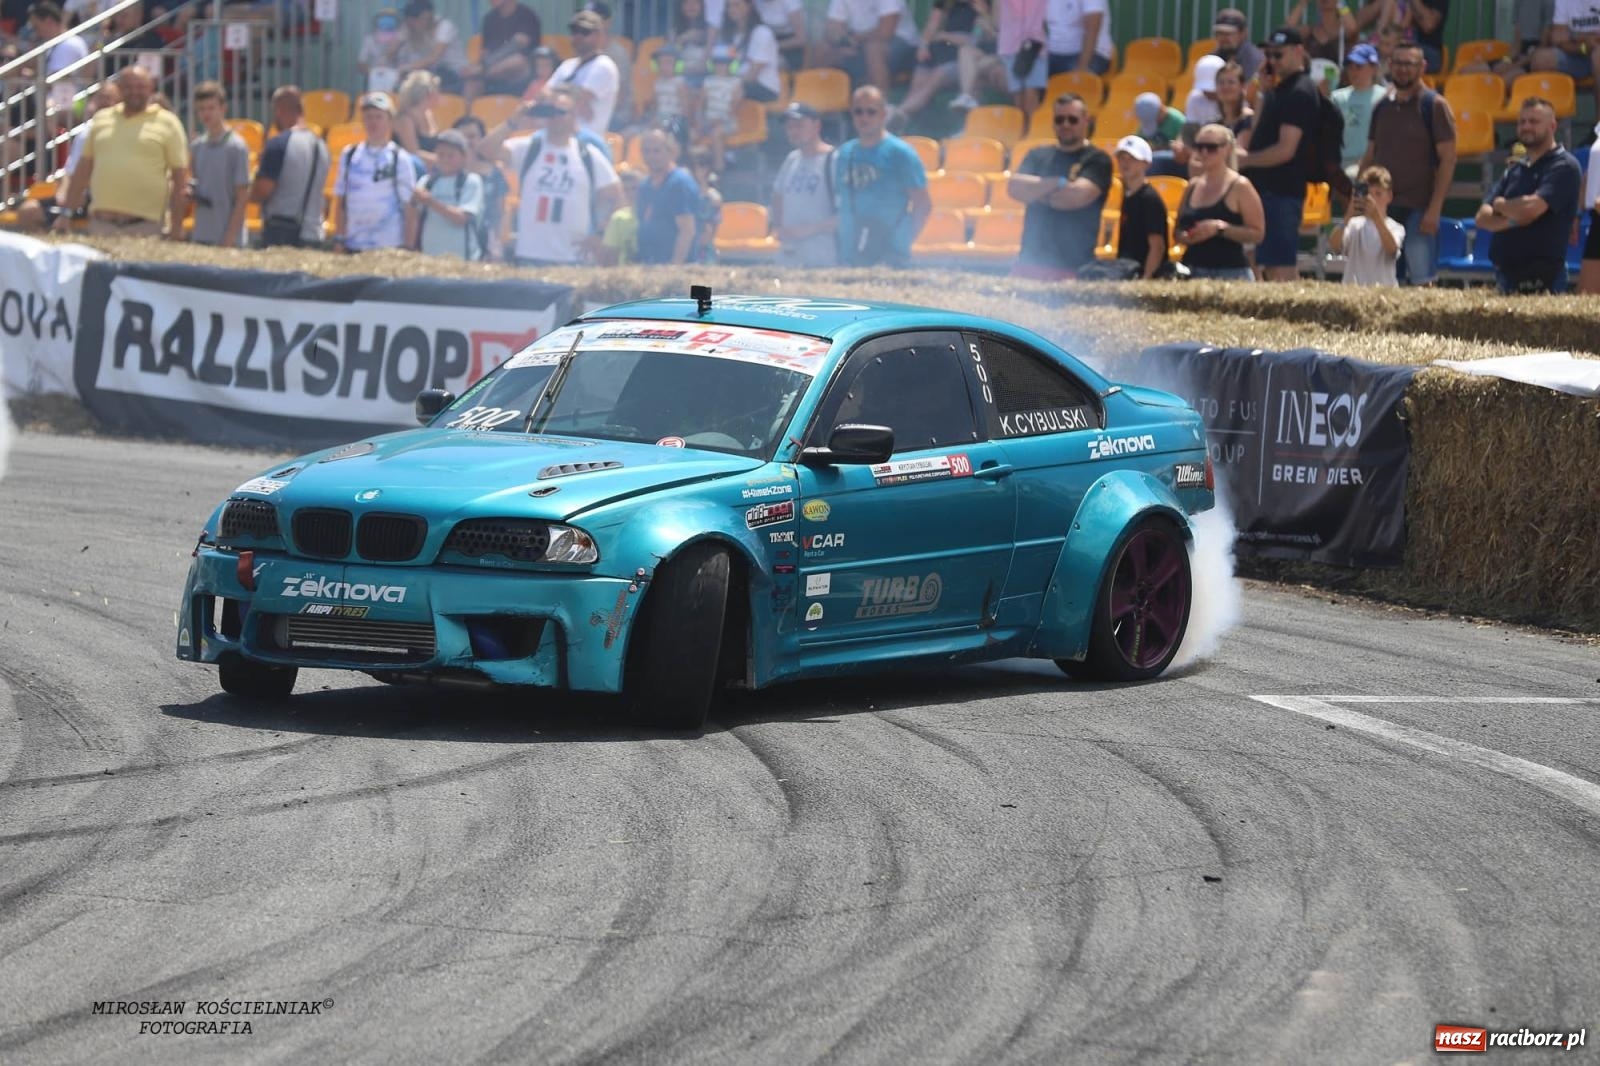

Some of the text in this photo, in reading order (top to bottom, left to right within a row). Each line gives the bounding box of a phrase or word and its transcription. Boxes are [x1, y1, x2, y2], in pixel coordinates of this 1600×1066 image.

[1, 290, 73, 343] OVA
[114, 299, 470, 403] RALLYSHOP
[446, 406, 521, 428] 500
[998, 408, 1089, 436] K.CYBULSKI
[1276, 389, 1368, 448] INEOS
[951, 456, 970, 474] 500
[803, 503, 830, 516] KAWON
[802, 533, 845, 549] VCAR
